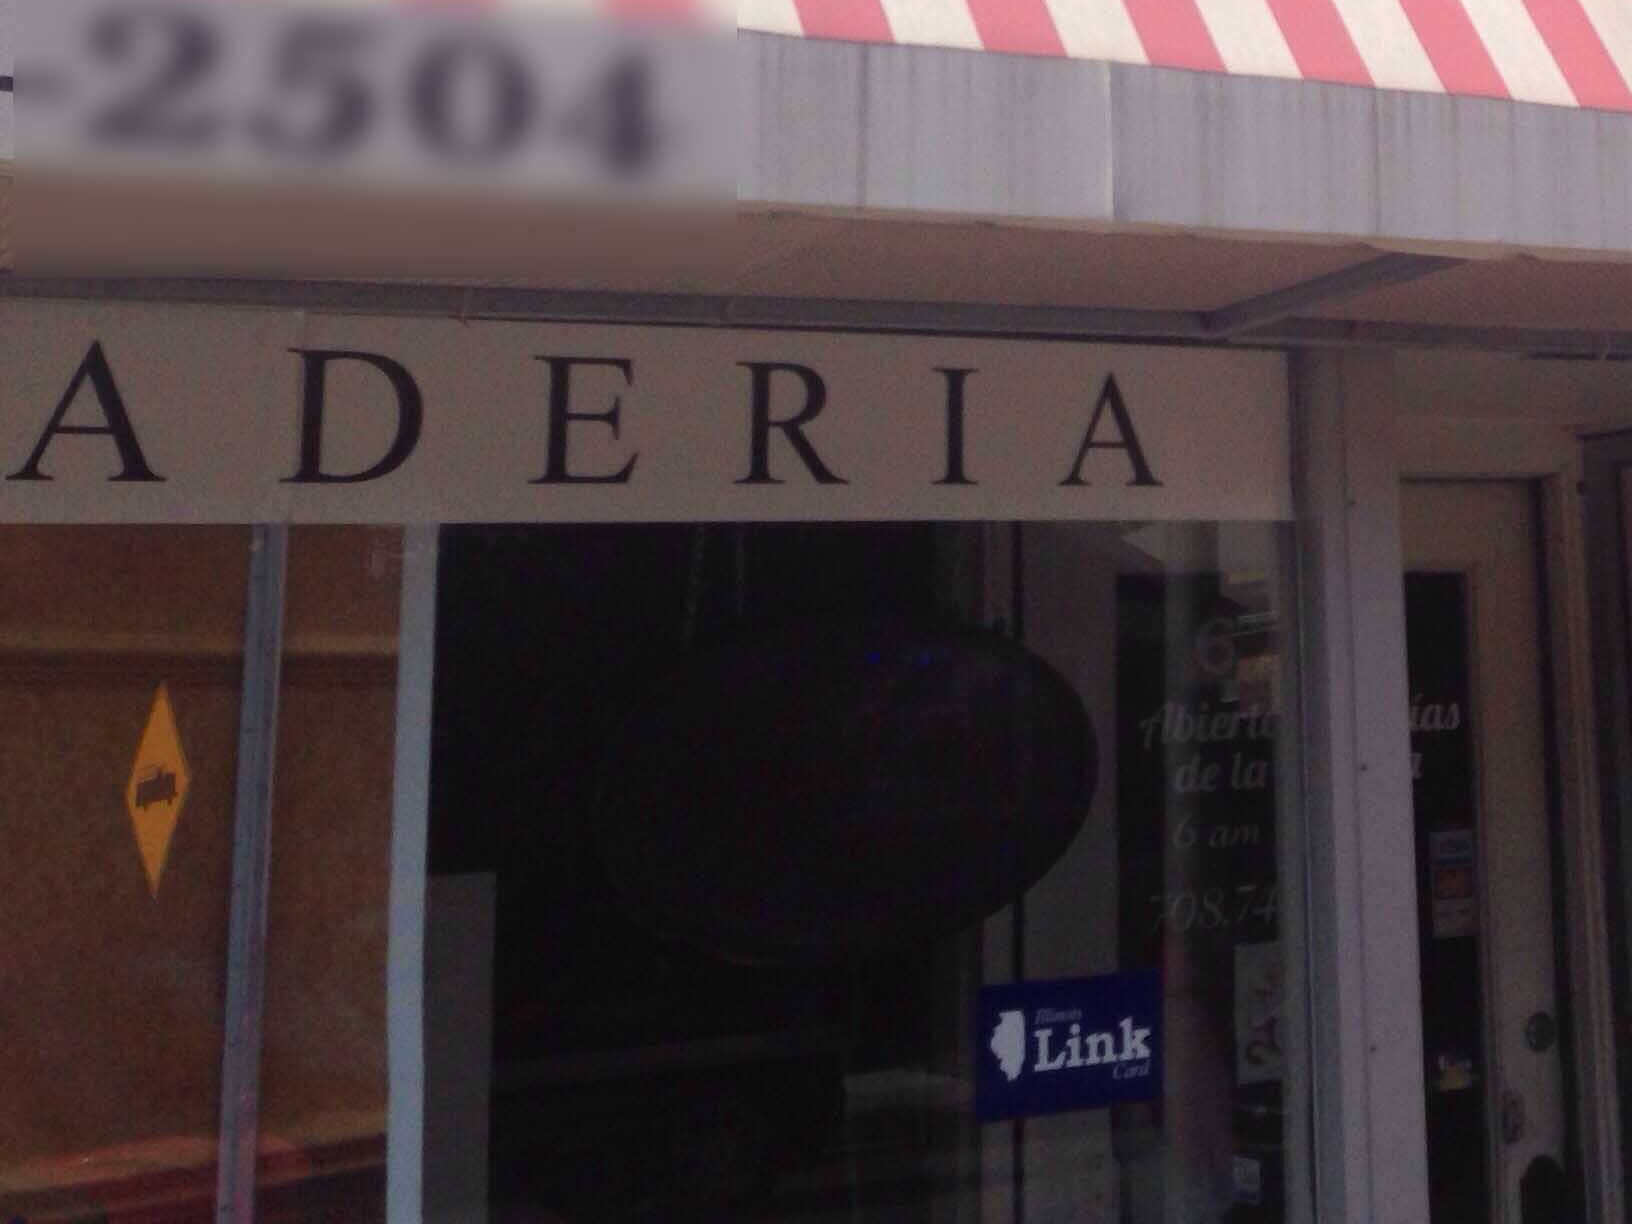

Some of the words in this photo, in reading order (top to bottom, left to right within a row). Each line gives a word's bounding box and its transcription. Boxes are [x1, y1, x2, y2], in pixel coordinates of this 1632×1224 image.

[10, 338, 1164, 488] ADERIA
[1169, 754, 1219, 795] de
[1231, 750, 1268, 790] la
[1032, 1015, 1153, 1072] Link
